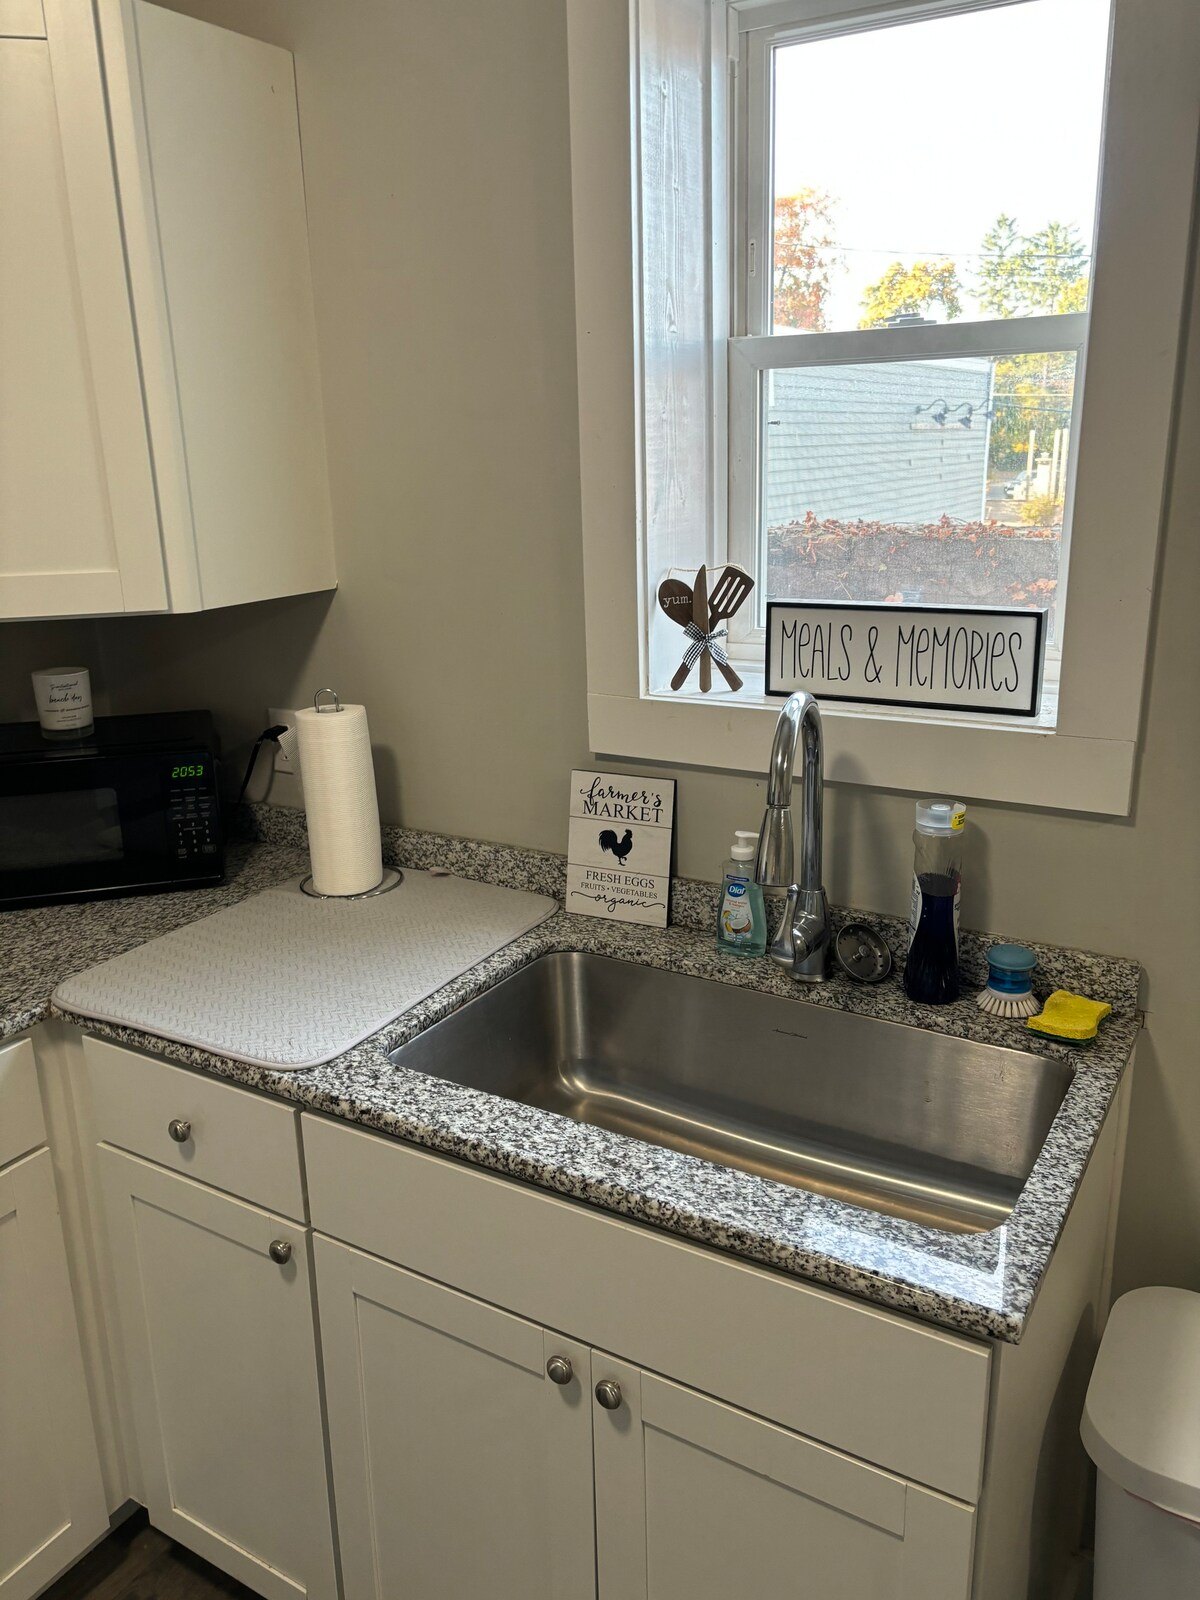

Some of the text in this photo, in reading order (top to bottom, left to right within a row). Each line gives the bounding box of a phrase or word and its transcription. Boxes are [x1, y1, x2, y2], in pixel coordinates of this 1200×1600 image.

[663, 595, 692, 608] yum.
[864, 626, 883, 684] &
[171, 765, 203, 778] 2053
[579, 776, 662, 807] farmer's
[583, 800, 663, 823] MARKET
[586, 870, 655, 889] FRESH EGGS
[580, 881, 658, 899] FRUITS VEGETABLES
[728, 885, 746, 895] Dial
[571, 890, 666, 912] organic
